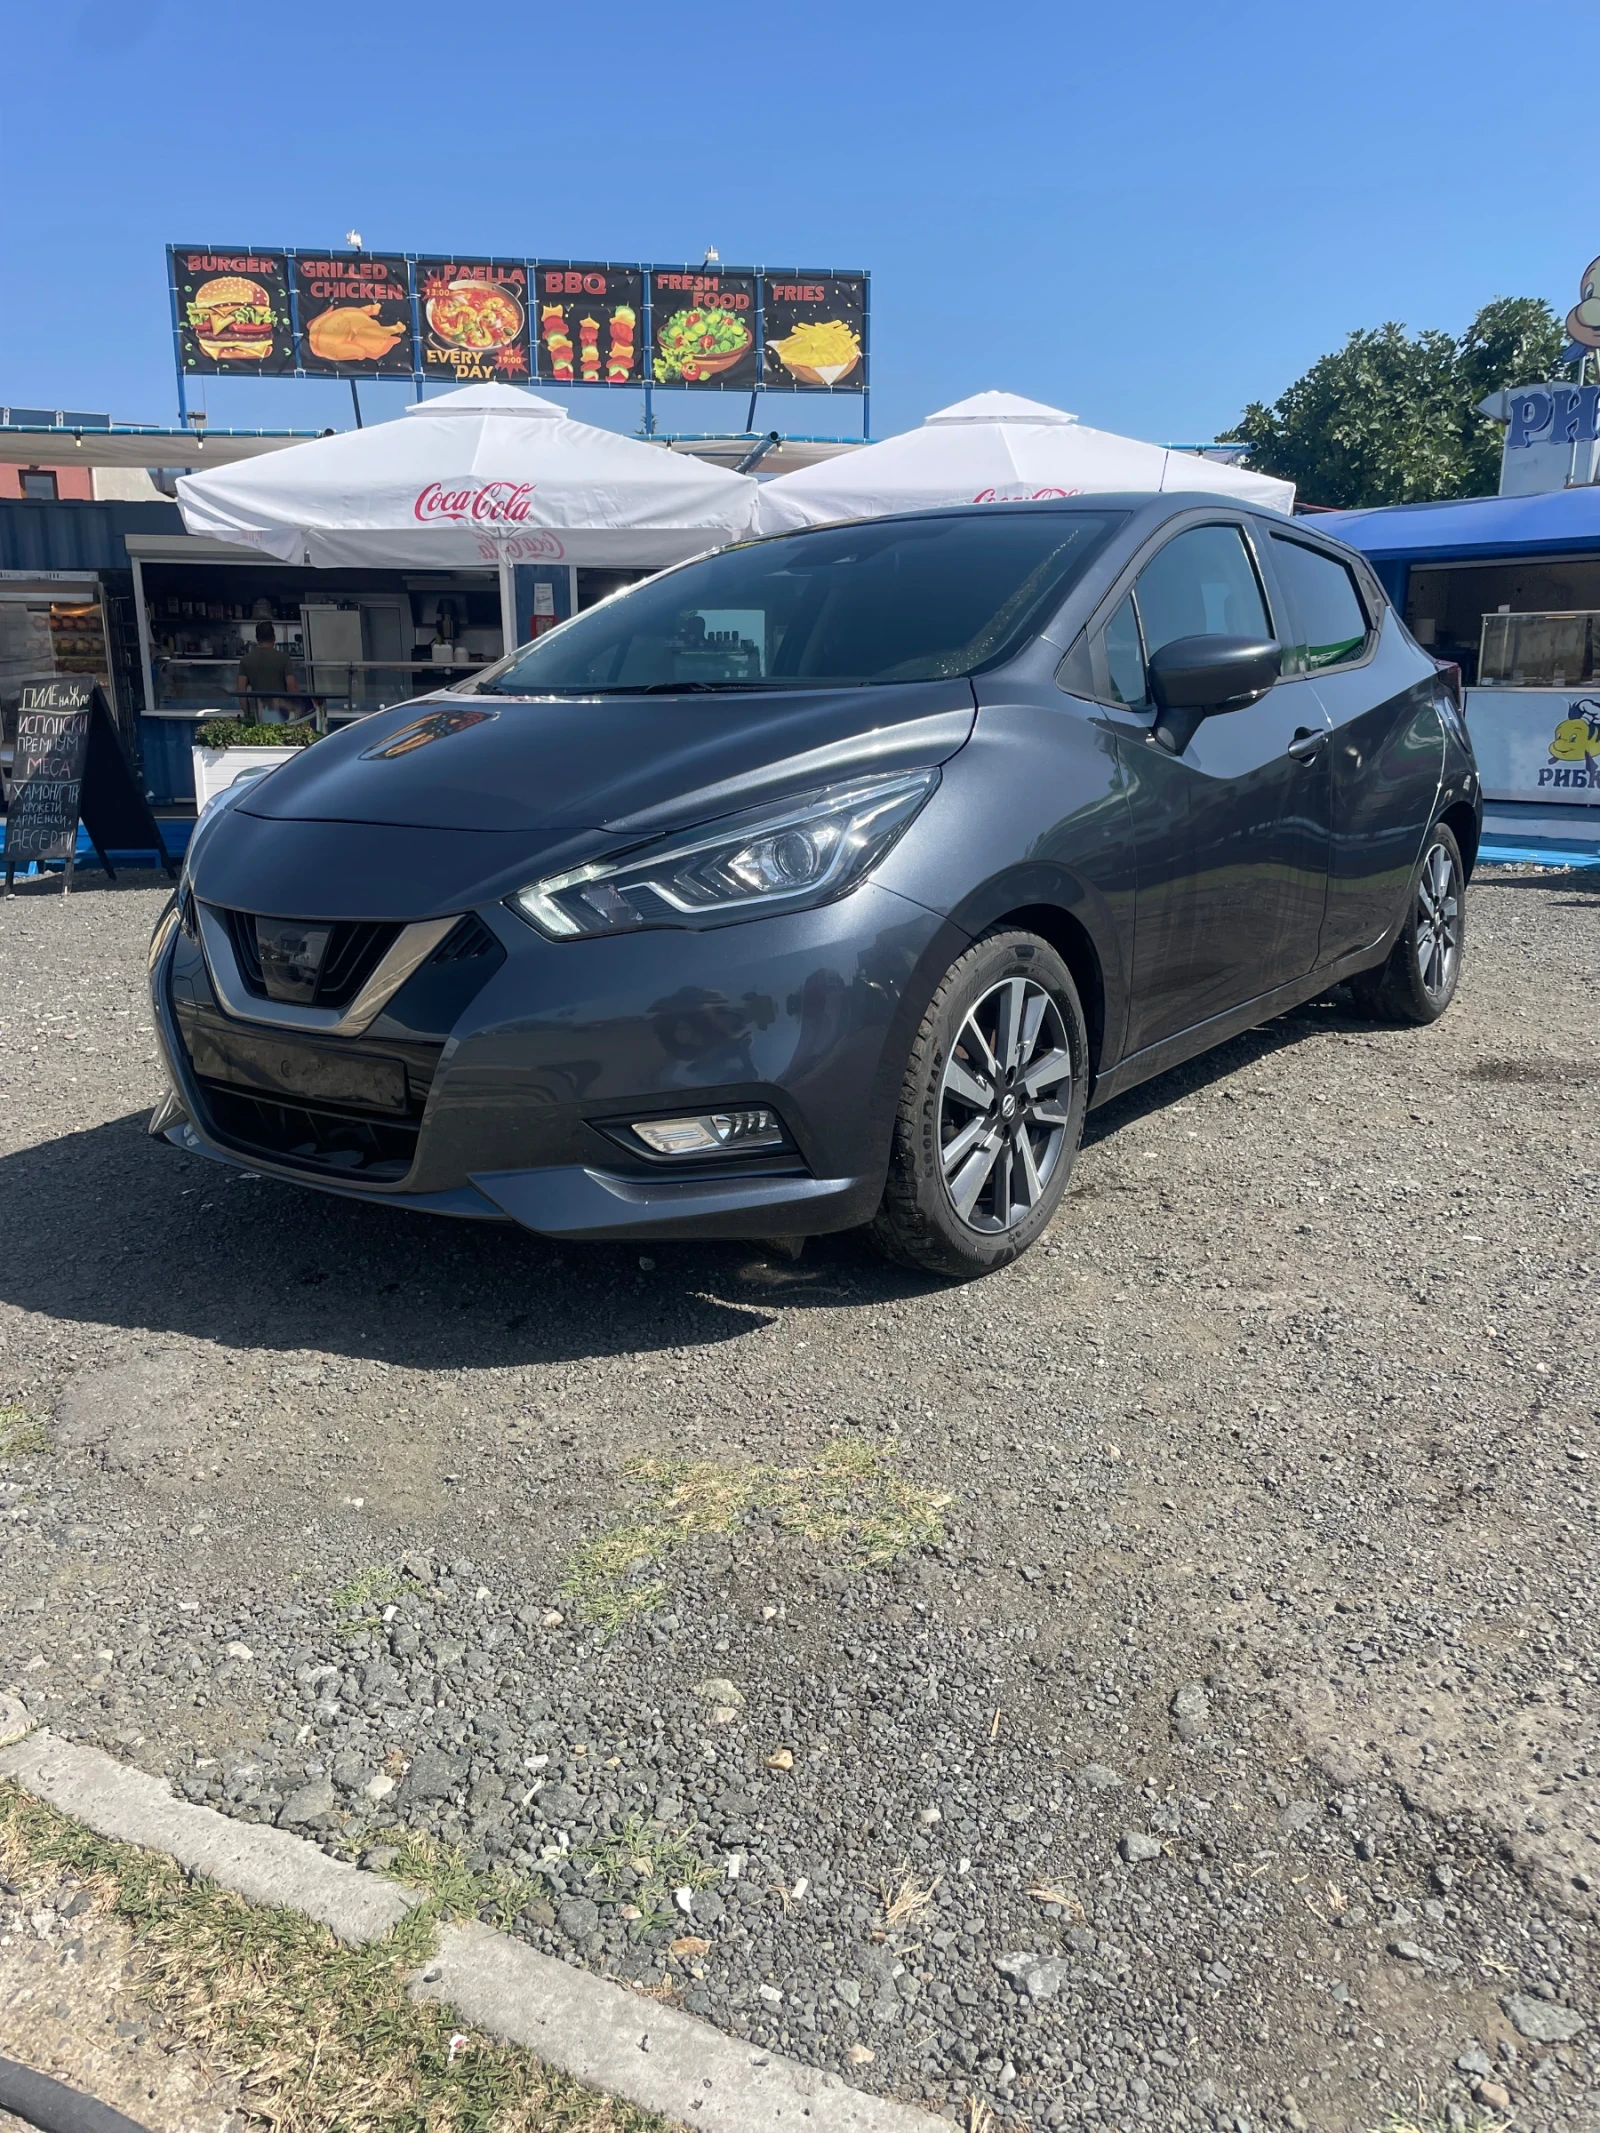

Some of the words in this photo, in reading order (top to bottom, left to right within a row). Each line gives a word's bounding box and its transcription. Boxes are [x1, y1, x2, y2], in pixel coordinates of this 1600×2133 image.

[187, 255, 274, 274] BURGER
[301, 261, 388, 280] GRILLED
[443, 264, 526, 285] PAELLA
[545, 271, 607, 295] BBQ
[657, 274, 719, 292] FRESH
[310, 281, 403, 300] CHICKEN
[426, 288, 450, 297] 13:00
[772, 285, 825, 302] FRIES
[692, 291, 750, 310] FOOD
[426, 349, 484, 365] EVERY
[498, 356, 522, 364] 19:00
[456, 364, 494, 379] DAY
[1507, 385, 1600, 449] РИ
[414, 482, 538, 522] Coca-Cola
[23, 684, 60, 710] ПИЛЕ
[26, 756, 71, 779] МЕСА
[8, 828, 74, 853] ДЕСЕРТИ
